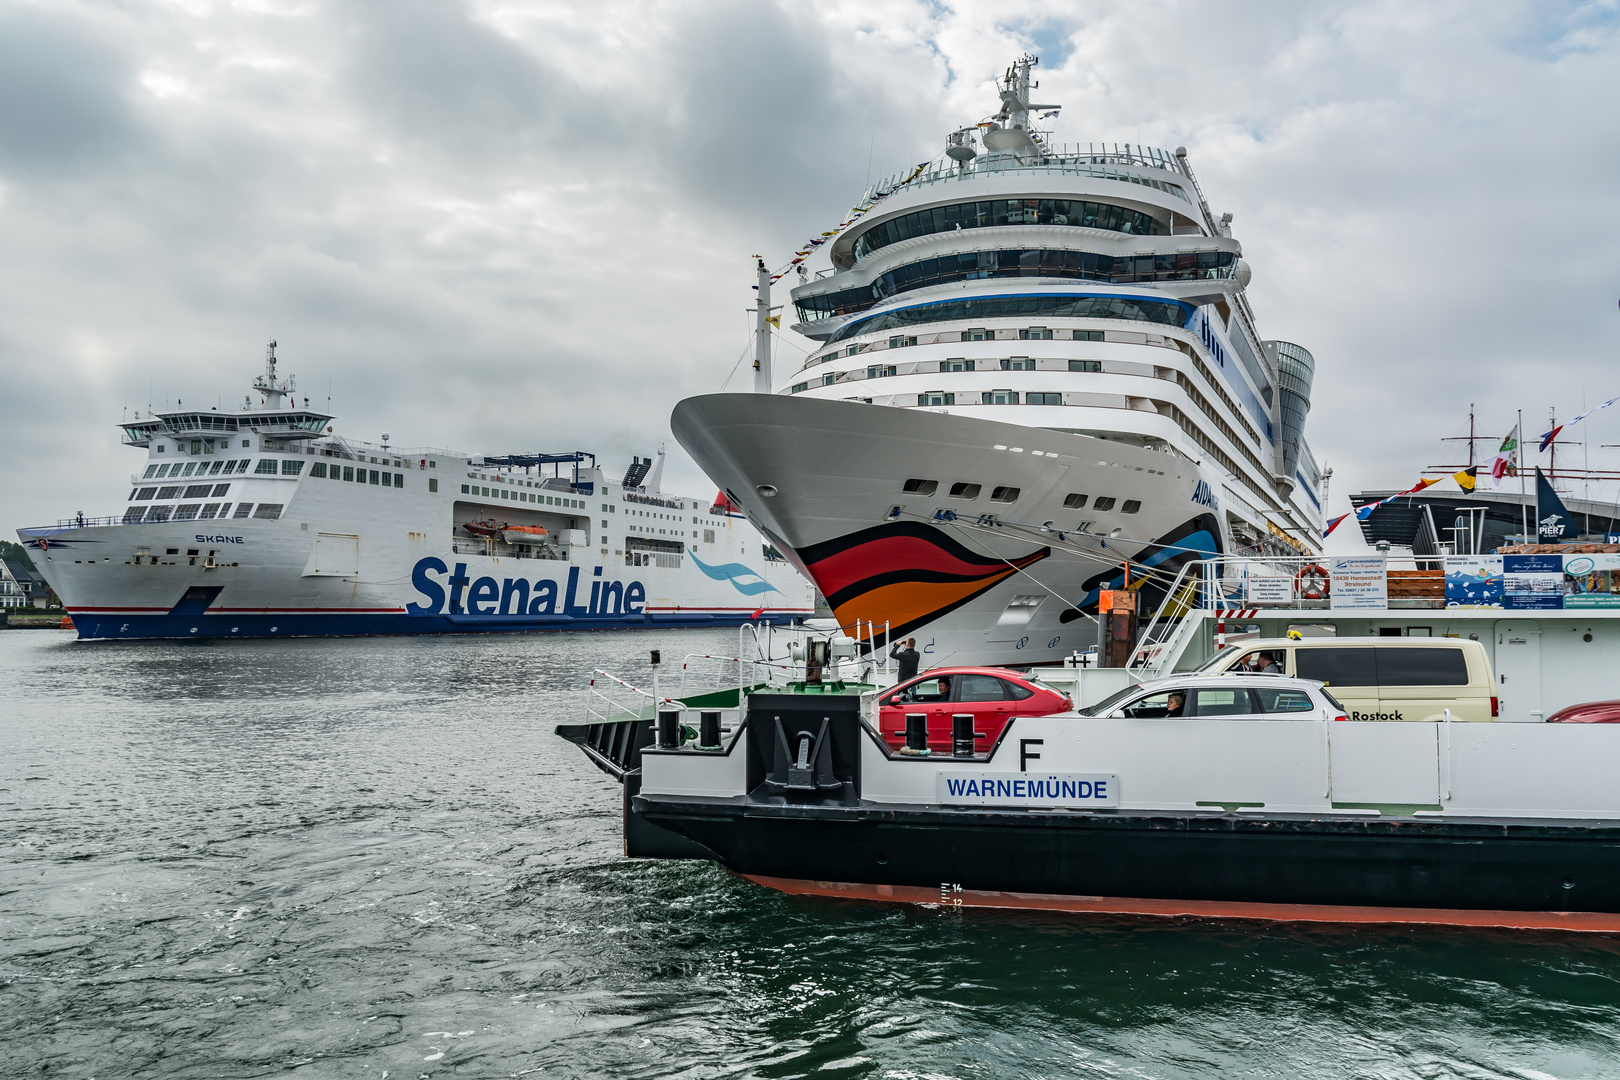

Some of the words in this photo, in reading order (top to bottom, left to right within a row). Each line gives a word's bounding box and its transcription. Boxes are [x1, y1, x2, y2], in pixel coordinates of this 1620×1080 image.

[195, 533, 244, 544] SKÅNE
[1352, 709, 1404, 721] Rostock
[1020, 738, 1044, 772] F
[947, 776, 1108, 799] WARNEMÜNDE
[952, 883, 963, 893] 14
